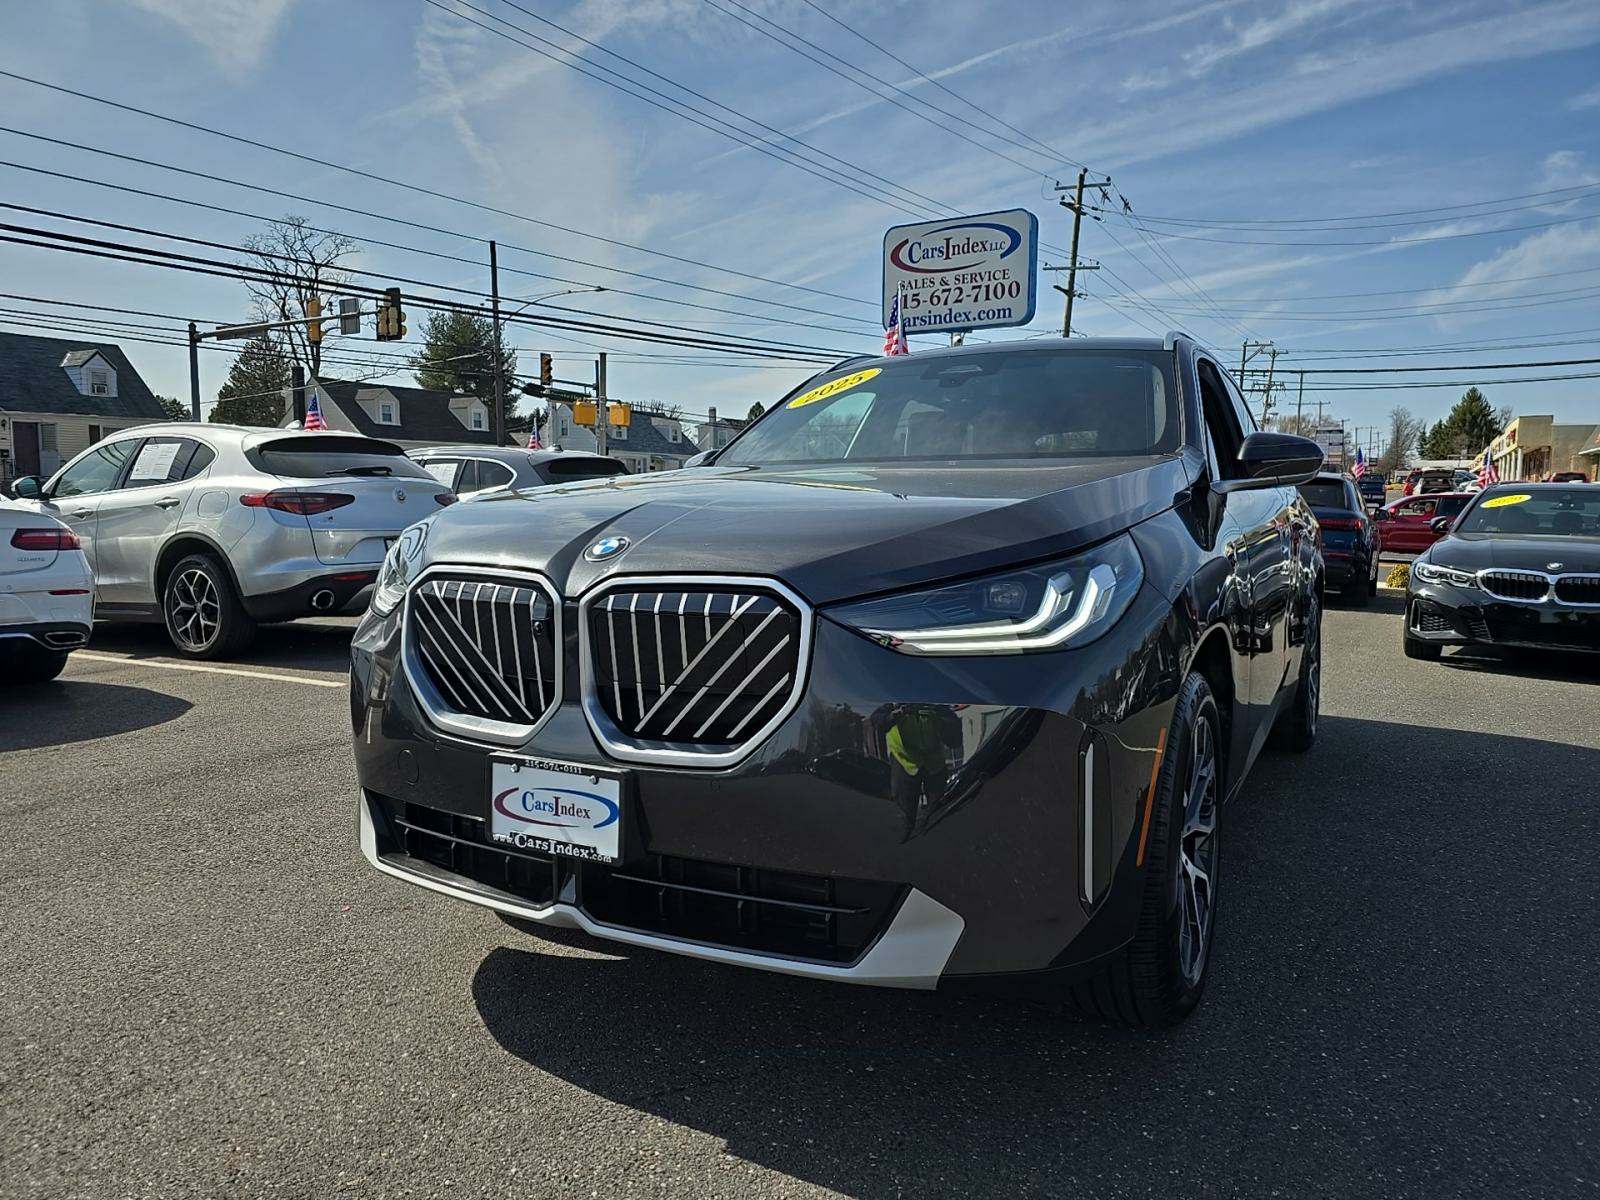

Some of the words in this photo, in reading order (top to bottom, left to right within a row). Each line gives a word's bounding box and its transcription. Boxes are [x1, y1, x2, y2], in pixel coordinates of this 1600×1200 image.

[908, 236, 989, 264] CarsIndex
[989, 240, 1006, 251] LLC
[899, 278, 936, 291] SALES
[939, 276, 949, 287] &
[954, 268, 1011, 284] SERVICE
[901, 280, 1021, 310] 15-672-7100
[902, 306, 1012, 328] arsindex.com
[804, 375, 863, 403] 2025
[521, 791, 591, 819] CarsIndex
[492, 832, 612, 863] www.CarsIndex.com
